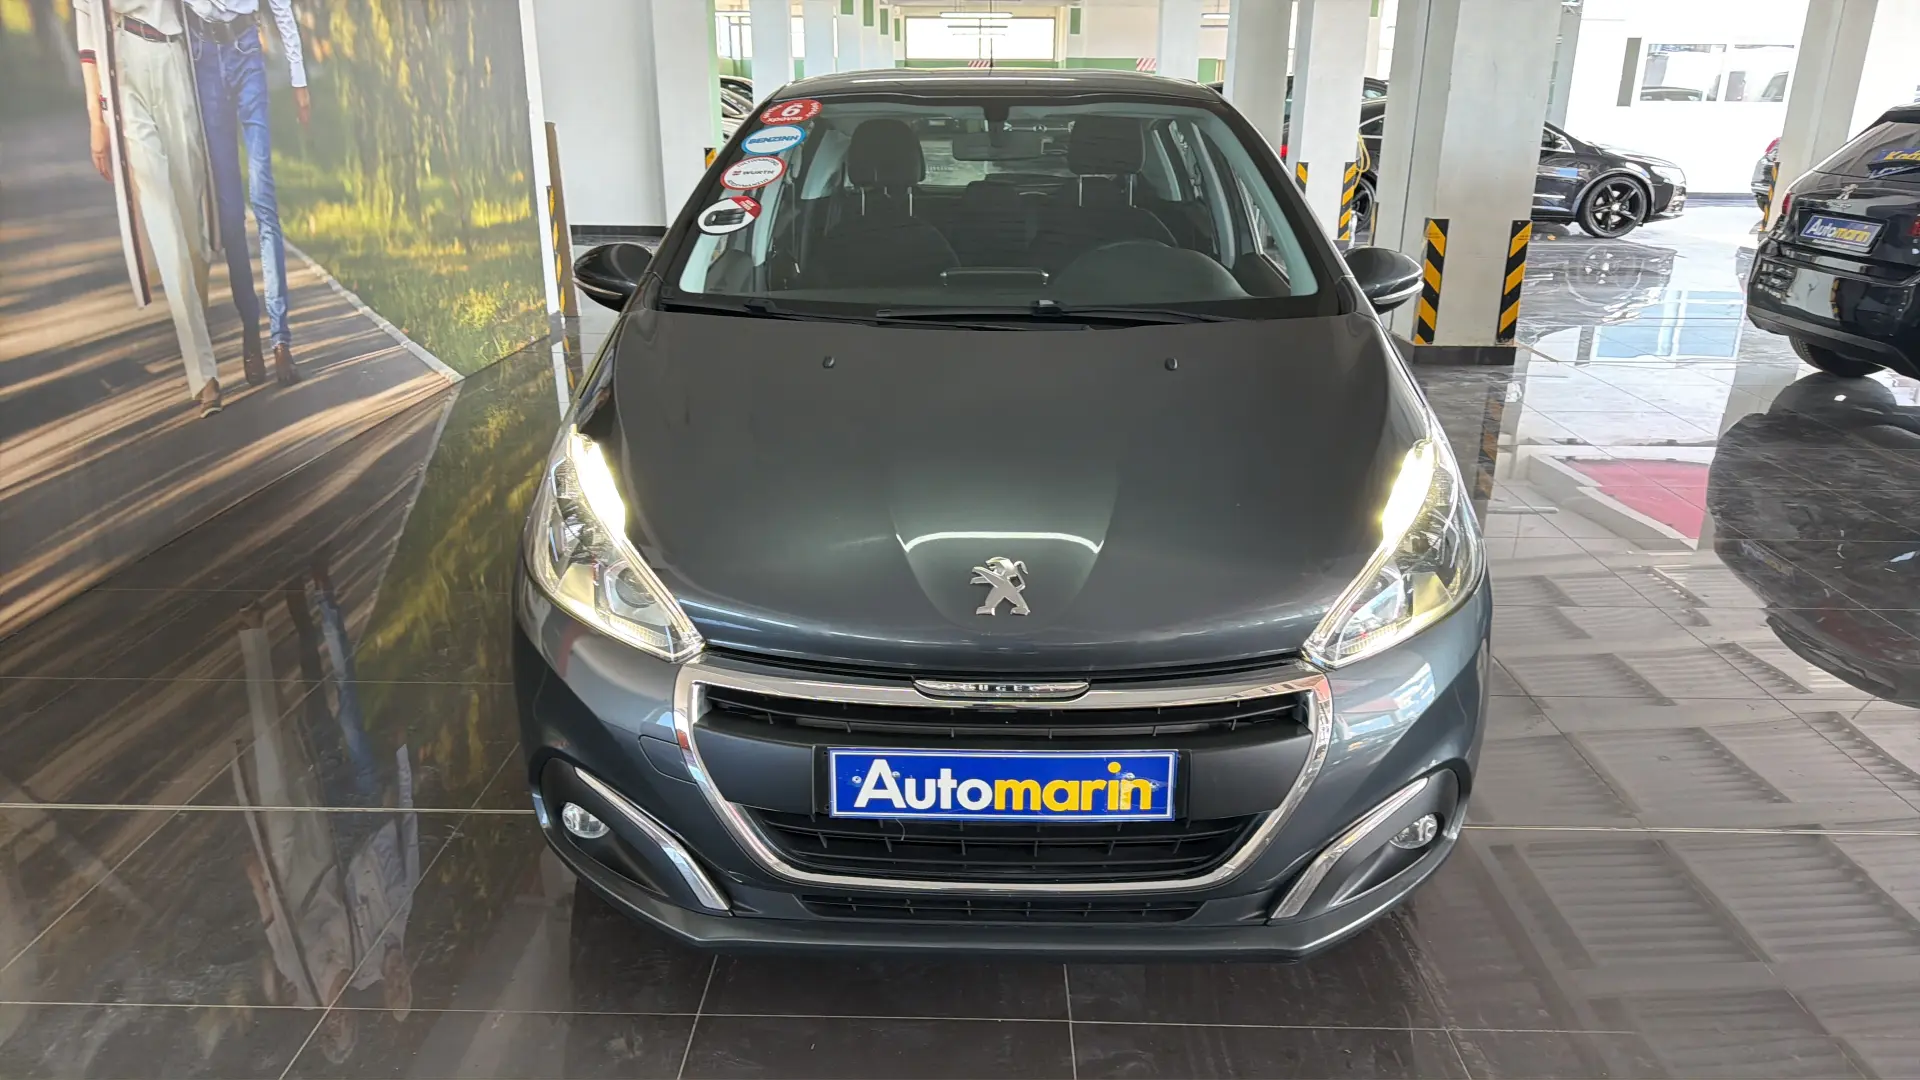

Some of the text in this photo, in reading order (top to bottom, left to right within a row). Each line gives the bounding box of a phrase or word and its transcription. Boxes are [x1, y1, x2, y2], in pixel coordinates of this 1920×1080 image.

[781, 104, 804, 117] 6
[1806, 219, 1872, 242] Automarin
[853, 758, 1152, 811] Automarin
